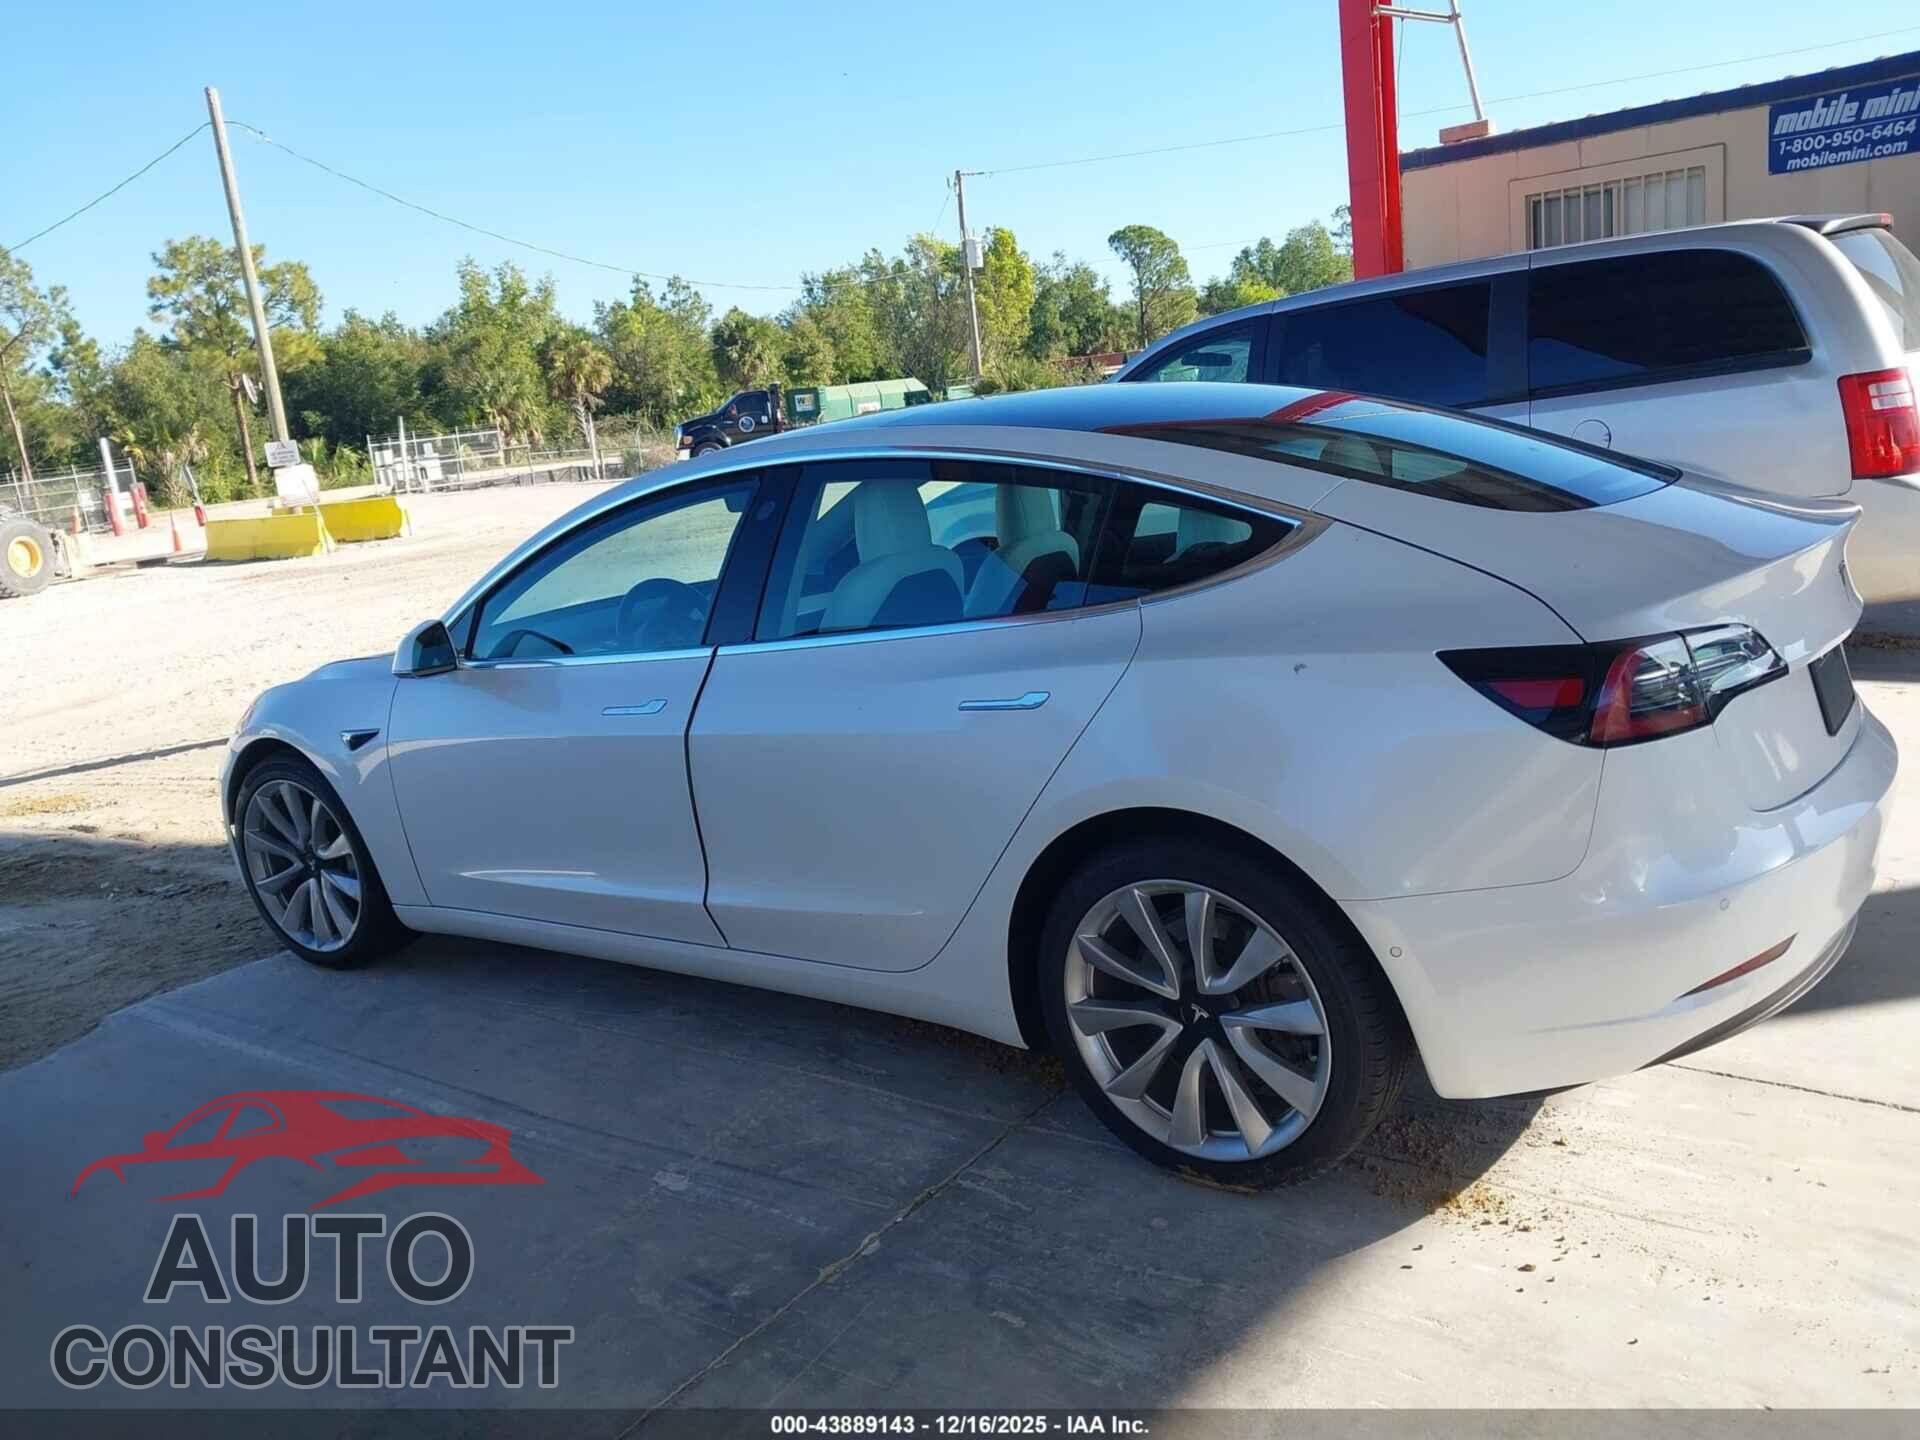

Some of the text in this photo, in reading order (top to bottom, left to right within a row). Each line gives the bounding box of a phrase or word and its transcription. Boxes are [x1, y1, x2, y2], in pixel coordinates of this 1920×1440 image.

[1774, 93, 1860, 135] mobile
[1779, 119, 1917, 155] 1-800-950-6464
[1786, 141, 1908, 170] mobilemini.com
